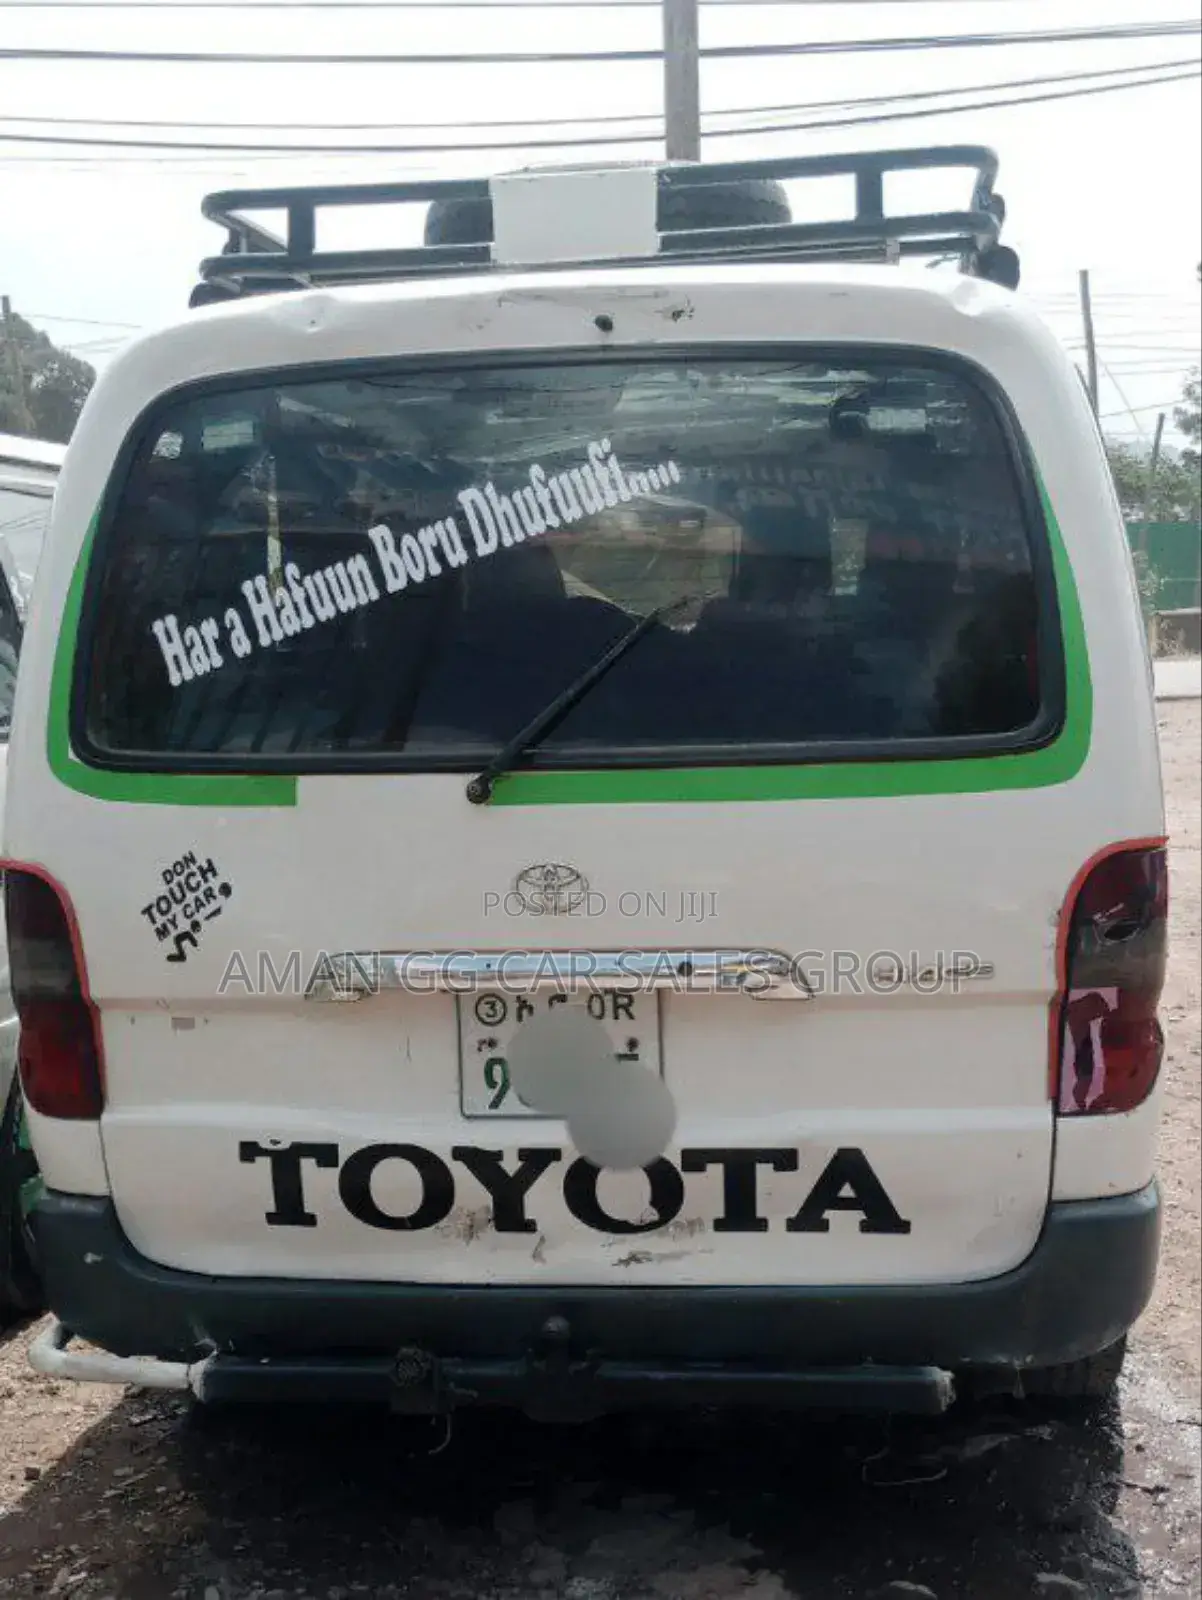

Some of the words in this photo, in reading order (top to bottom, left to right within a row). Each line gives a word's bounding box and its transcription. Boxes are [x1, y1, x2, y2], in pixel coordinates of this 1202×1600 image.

[152, 614, 224, 686] Har
[224, 608, 252, 658] a
[241, 557, 381, 647] Hafuun
[368, 516, 469, 594] Boru
[141, 858, 219, 925] TOUCH
[162, 850, 197, 885] DON
[154, 913, 179, 942] MY
[182, 886, 218, 919] CAR
[239, 1140, 911, 1234] TOYOTA
